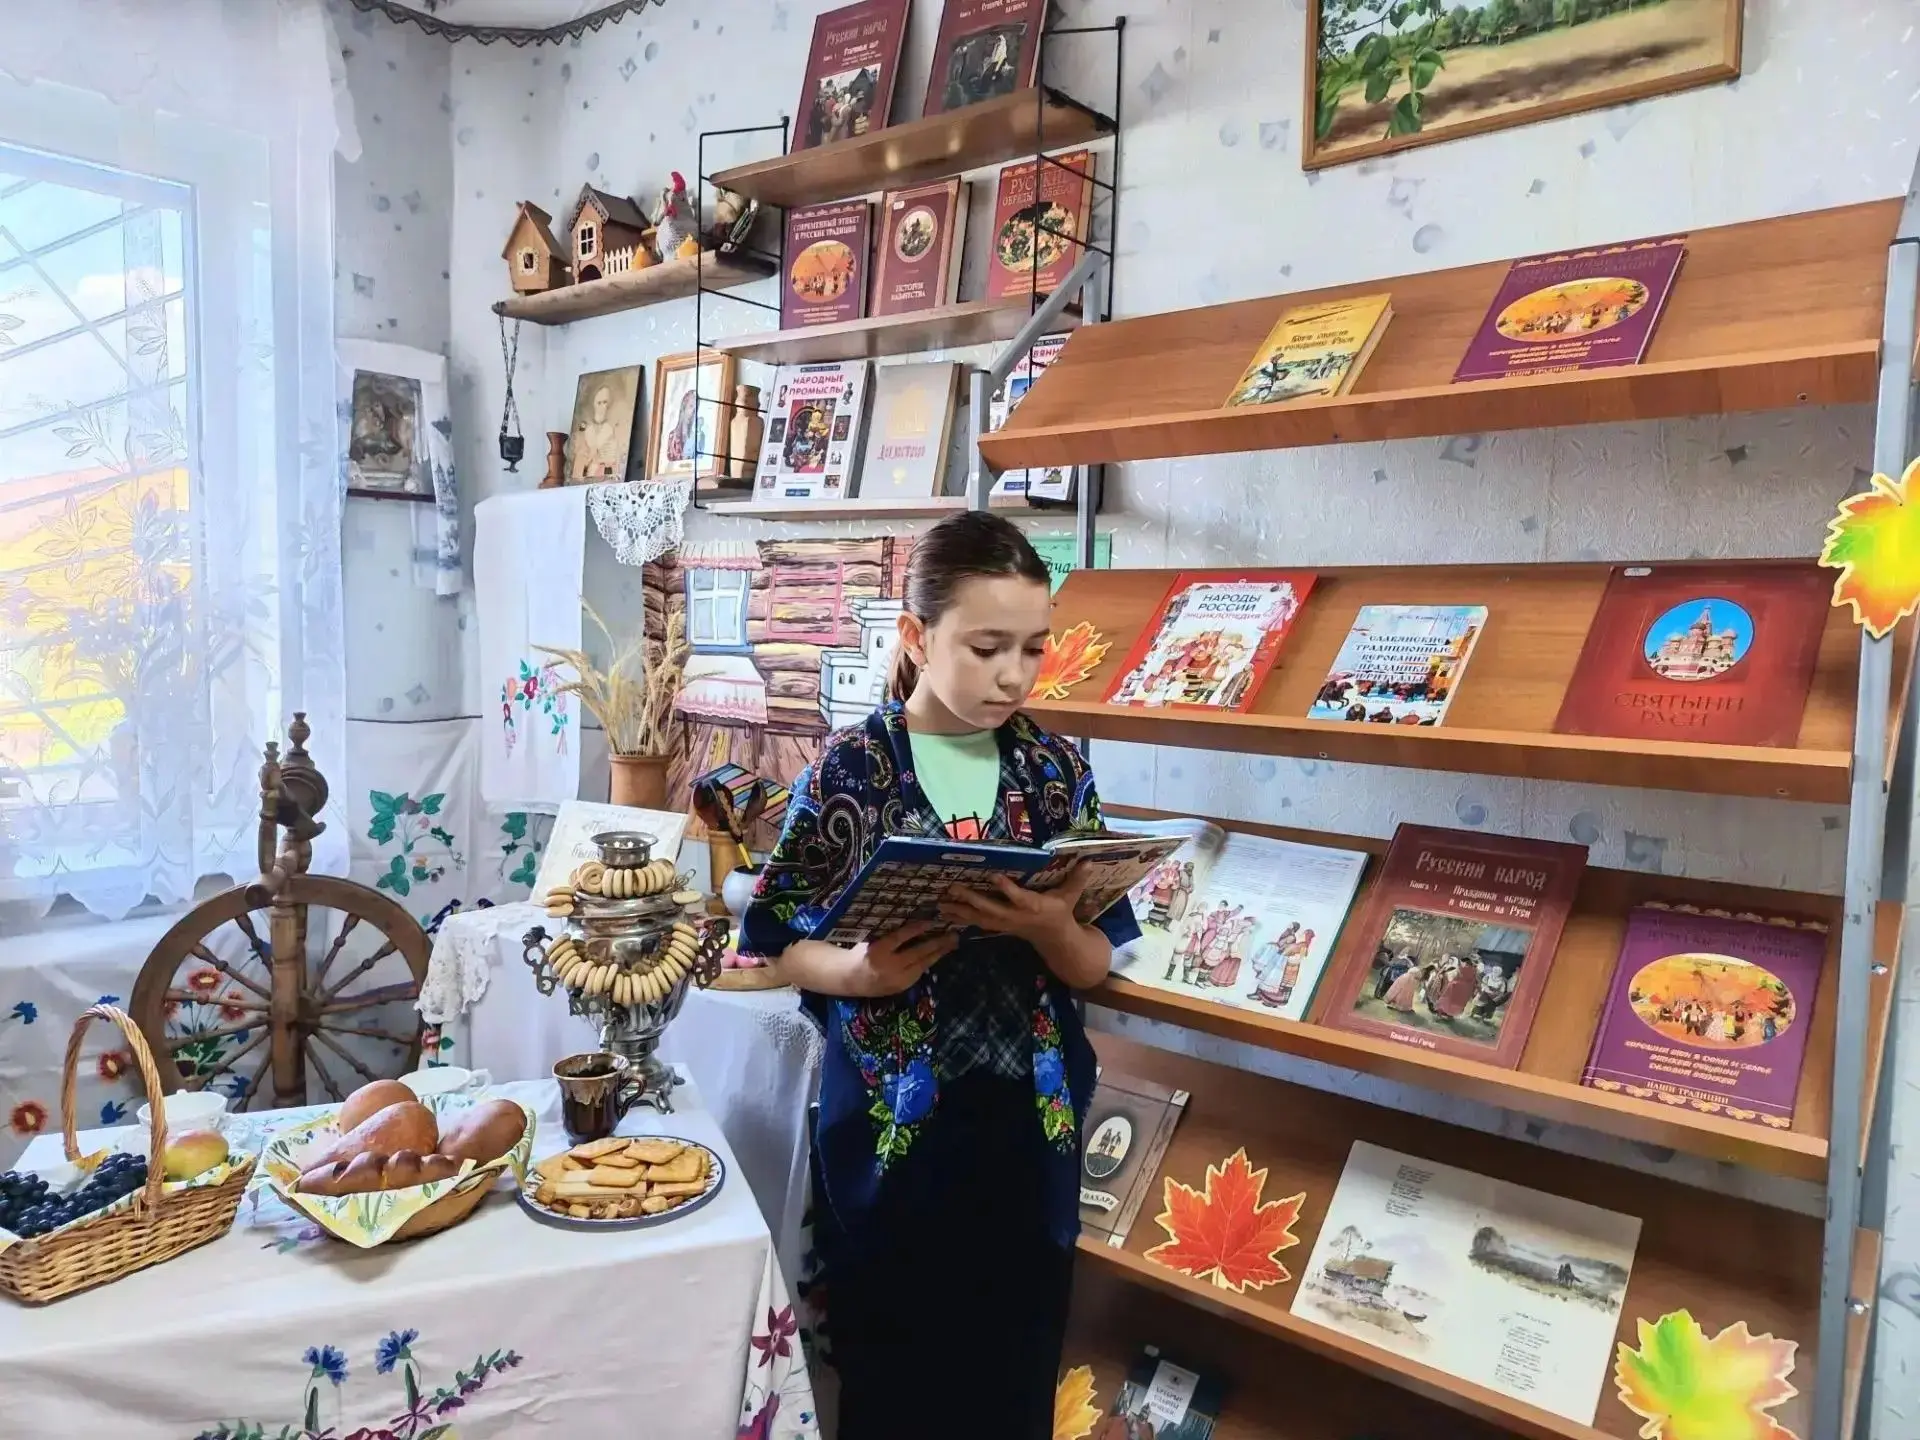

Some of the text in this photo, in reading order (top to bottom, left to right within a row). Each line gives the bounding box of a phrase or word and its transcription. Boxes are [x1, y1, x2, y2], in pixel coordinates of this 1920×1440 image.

[793, 374, 845, 385] НАРОДНЫЕ
[789, 386, 844, 396] ПРОМЫСЛЫ
[1202, 593, 1262, 603] НАРОДЫ
[1197, 603, 1257, 612] РОССИИ
[1369, 635, 1445, 643] СЛАВЯНСКИЕ
[1356, 644, 1452, 653] ТРАДИЦИОННЫЕ
[1361, 654, 1429, 663] ВЕРОВАНИЯ
[1358, 663, 1429, 672] ПРАЗДНИКИ
[1613, 692, 1744, 712] СВЯТЫНИ
[1640, 709, 1708, 728] РУСИ
[1409, 880, 1430, 890] Книга
[1509, 904, 1532, 919] Руси
[1646, 1081, 1730, 1105] НАШИ ТРАДИЦИИ
